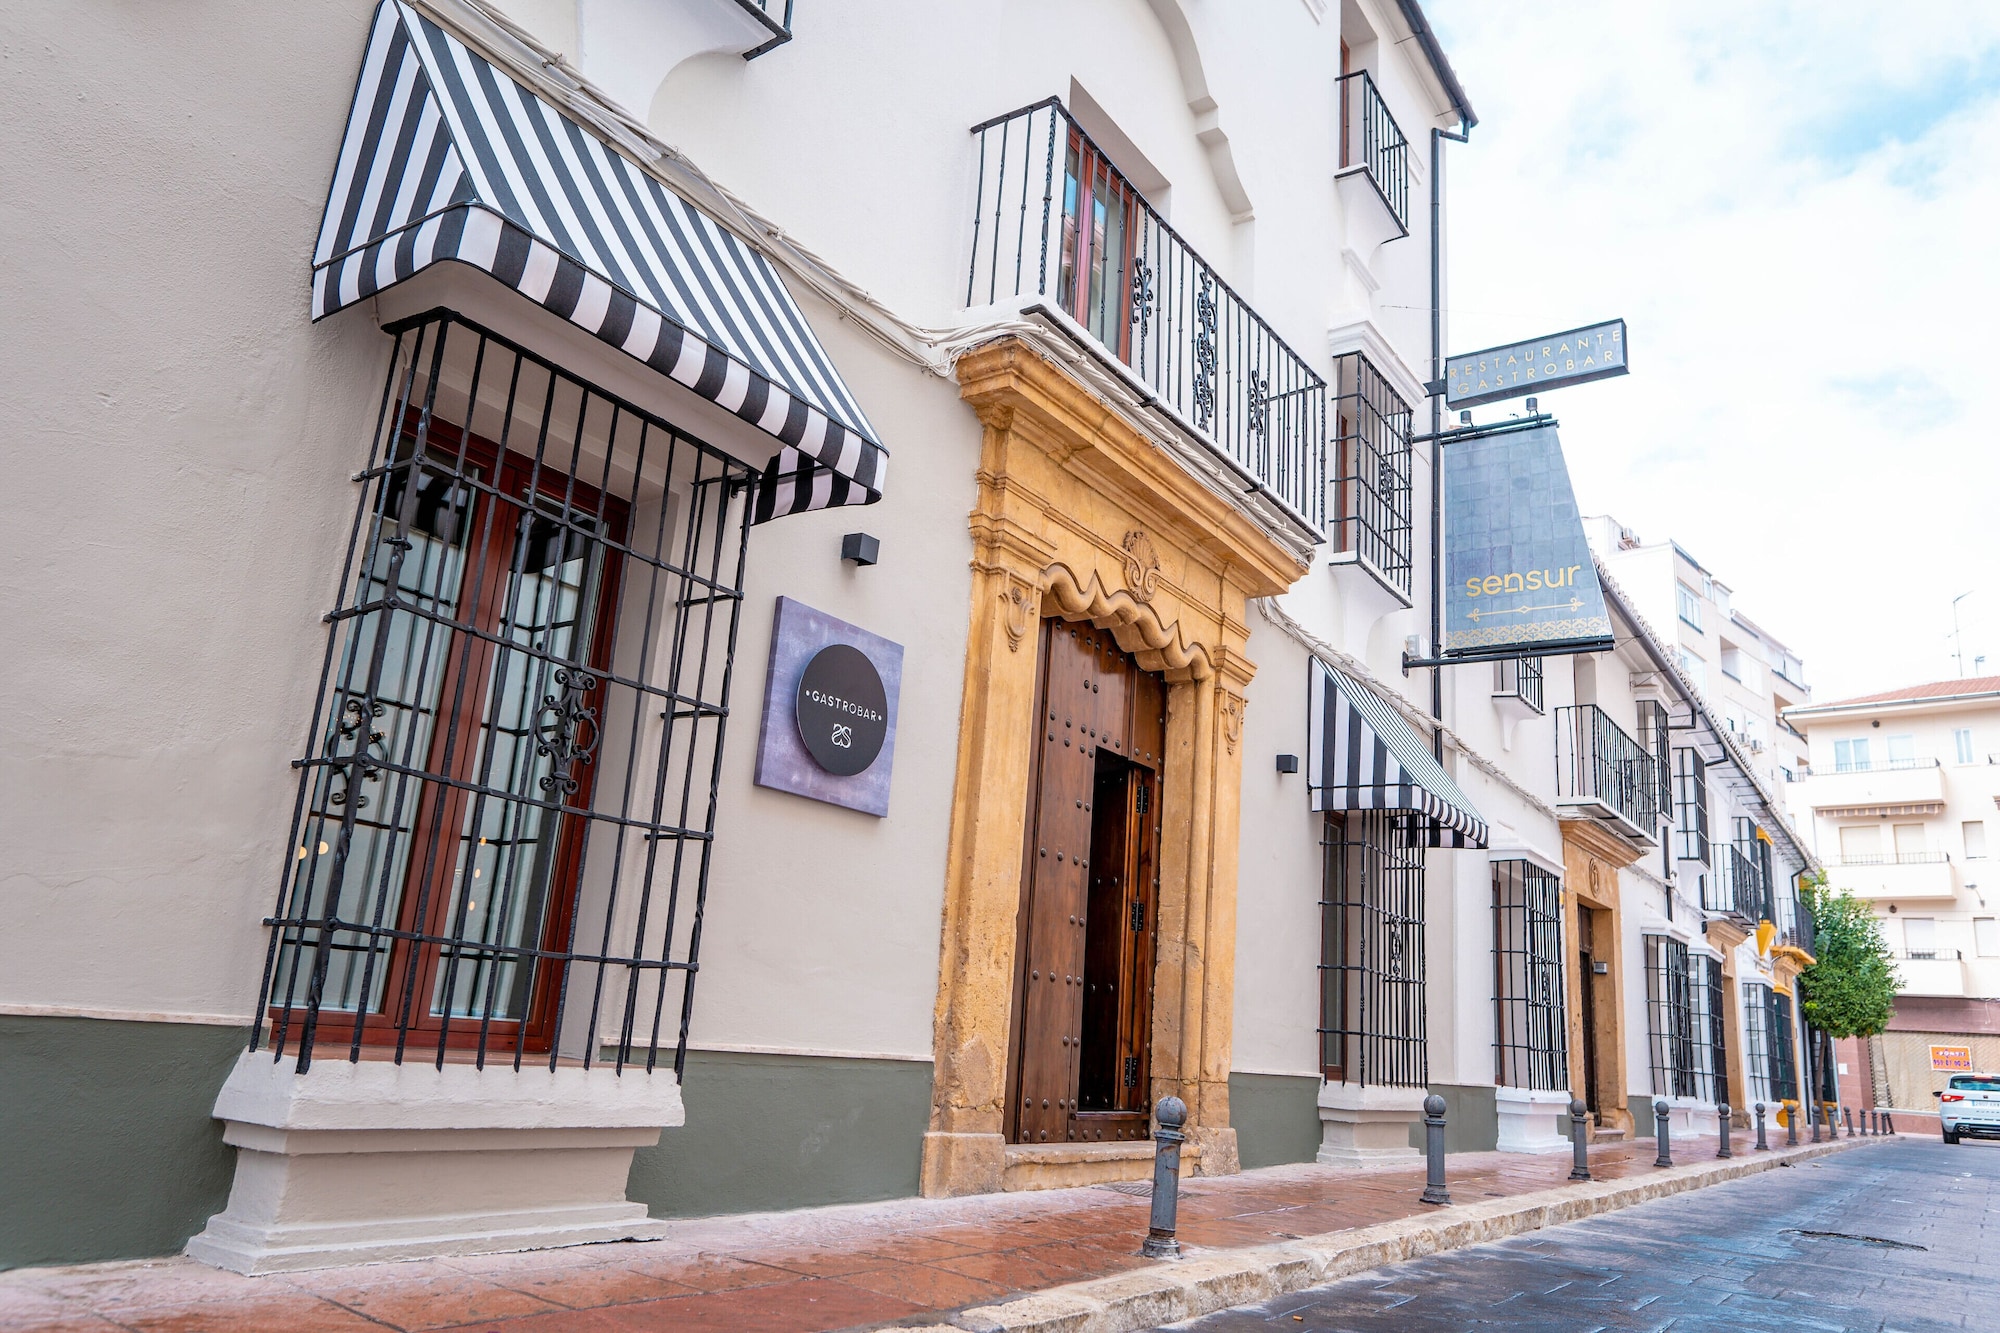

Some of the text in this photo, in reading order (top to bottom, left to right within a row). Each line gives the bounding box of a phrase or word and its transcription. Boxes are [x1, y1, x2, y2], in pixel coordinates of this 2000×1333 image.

[1449, 330, 1622, 378] RESTAURANTE
[1457, 350, 1614, 395] GASTROBAR
[1465, 565, 1581, 597] sensur
[811, 690, 877, 721] GASTROBAR
